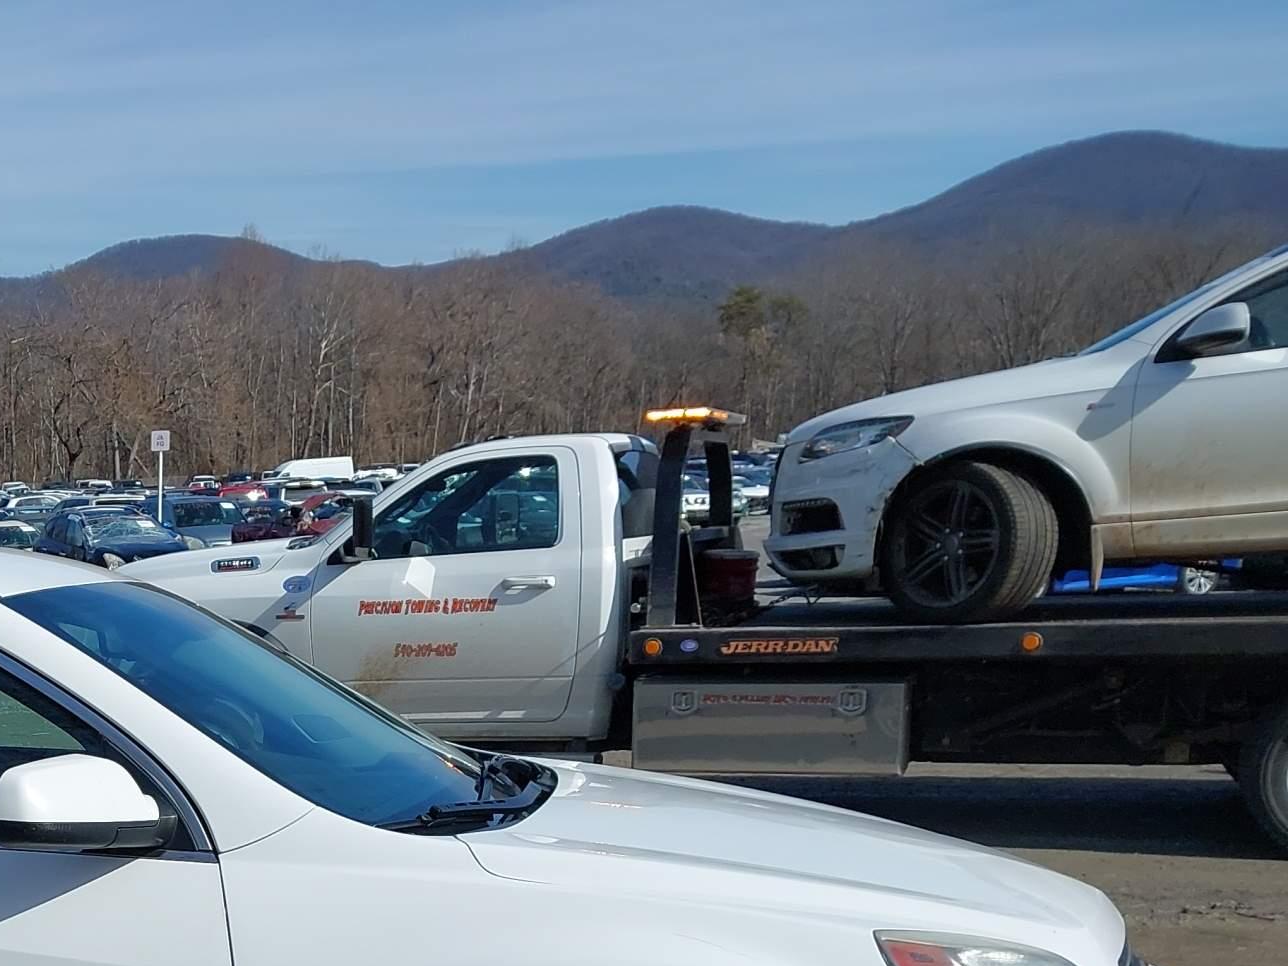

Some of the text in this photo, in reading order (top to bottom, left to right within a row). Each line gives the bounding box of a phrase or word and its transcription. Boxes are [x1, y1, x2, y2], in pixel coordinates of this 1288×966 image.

[404, 599, 441, 615] TOWING
[442, 598, 449, 614] &
[451, 598, 498, 614] RECOVERY
